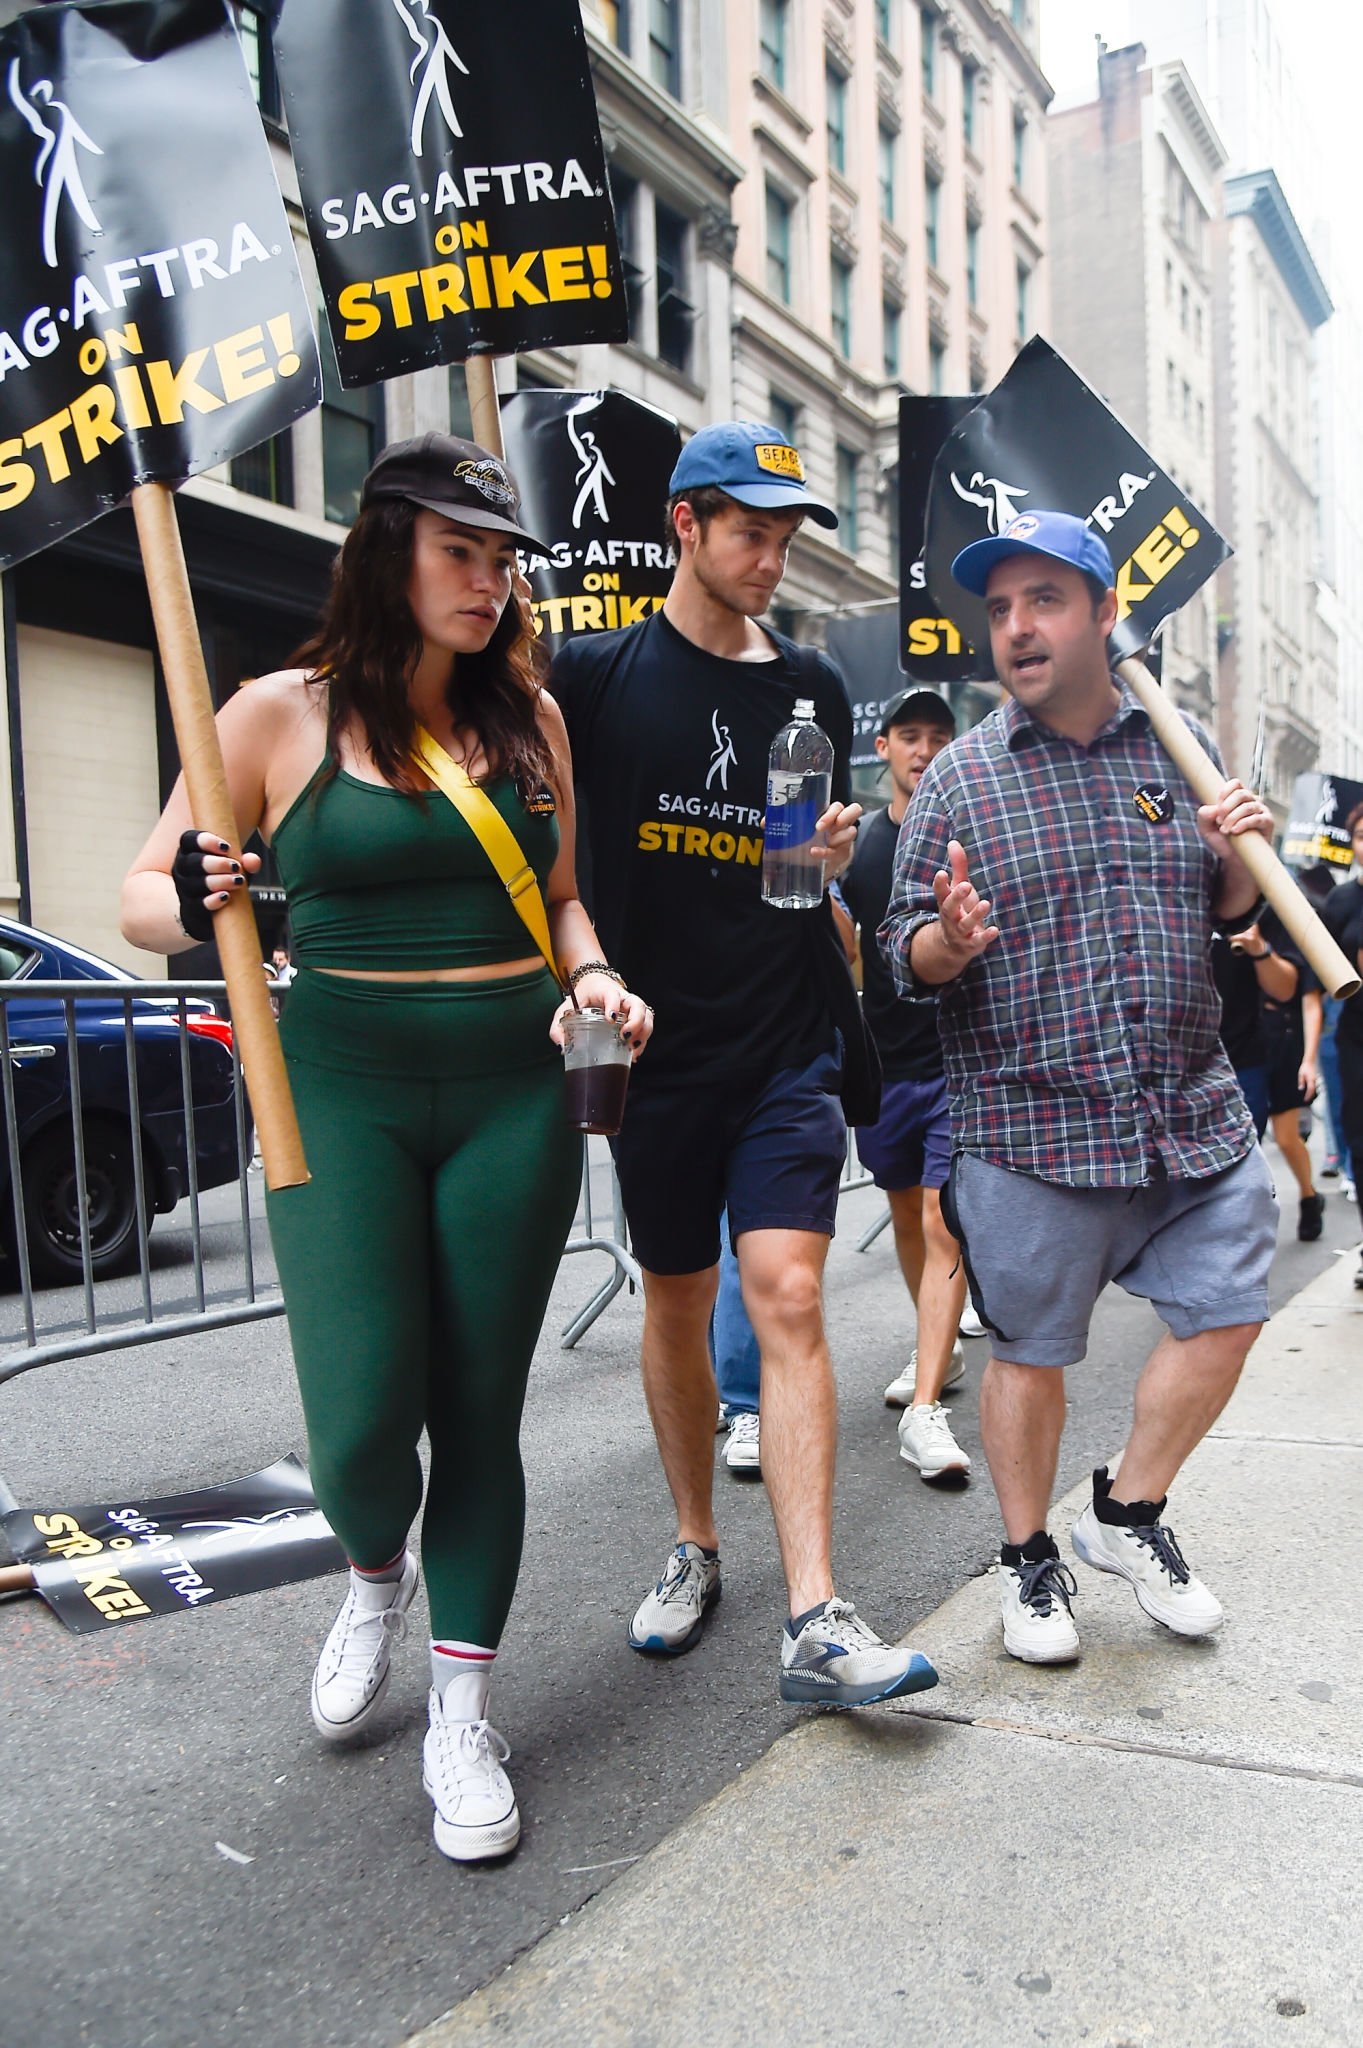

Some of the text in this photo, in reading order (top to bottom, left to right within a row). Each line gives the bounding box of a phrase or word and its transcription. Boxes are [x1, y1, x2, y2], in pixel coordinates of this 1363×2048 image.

[434, 220, 489, 255] ON
[0, 222, 272, 381] AG·AFTRA
[338, 244, 612, 341] STRIKE!
[78, 322, 144, 376] ON
[0, 312, 301, 511] STRIKE!
[582, 572, 621, 592] ON
[658, 793, 761, 827] SAG·AFTR
[637, 821, 764, 867] STRON
[33, 1513, 153, 1621] STRIKE!
[108, 1537, 144, 1566] ON
